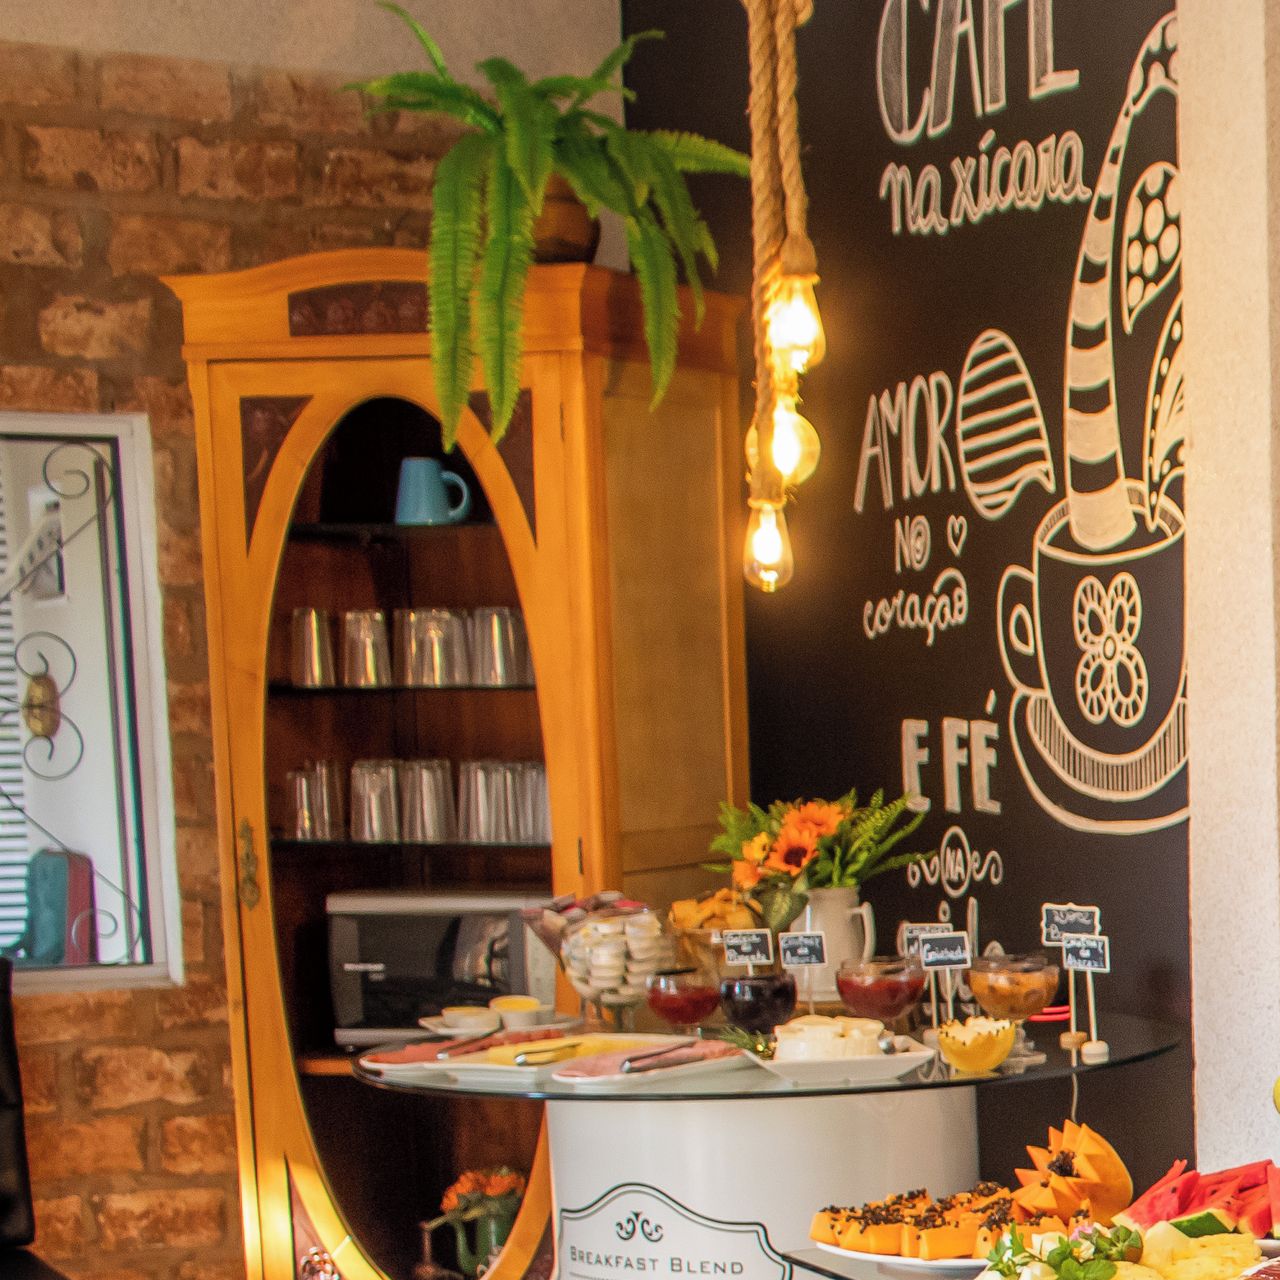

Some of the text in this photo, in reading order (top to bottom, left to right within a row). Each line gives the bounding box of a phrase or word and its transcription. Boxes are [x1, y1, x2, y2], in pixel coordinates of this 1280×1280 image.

[879, 128, 1093, 236] na xícara
[853, 370, 956, 515] AMOR
[894, 513, 931, 574] NO
[863, 566, 969, 647] coração
[901, 688, 1001, 815] E FÉ
[569, 1246, 744, 1275] BREAKFAST BLEND
